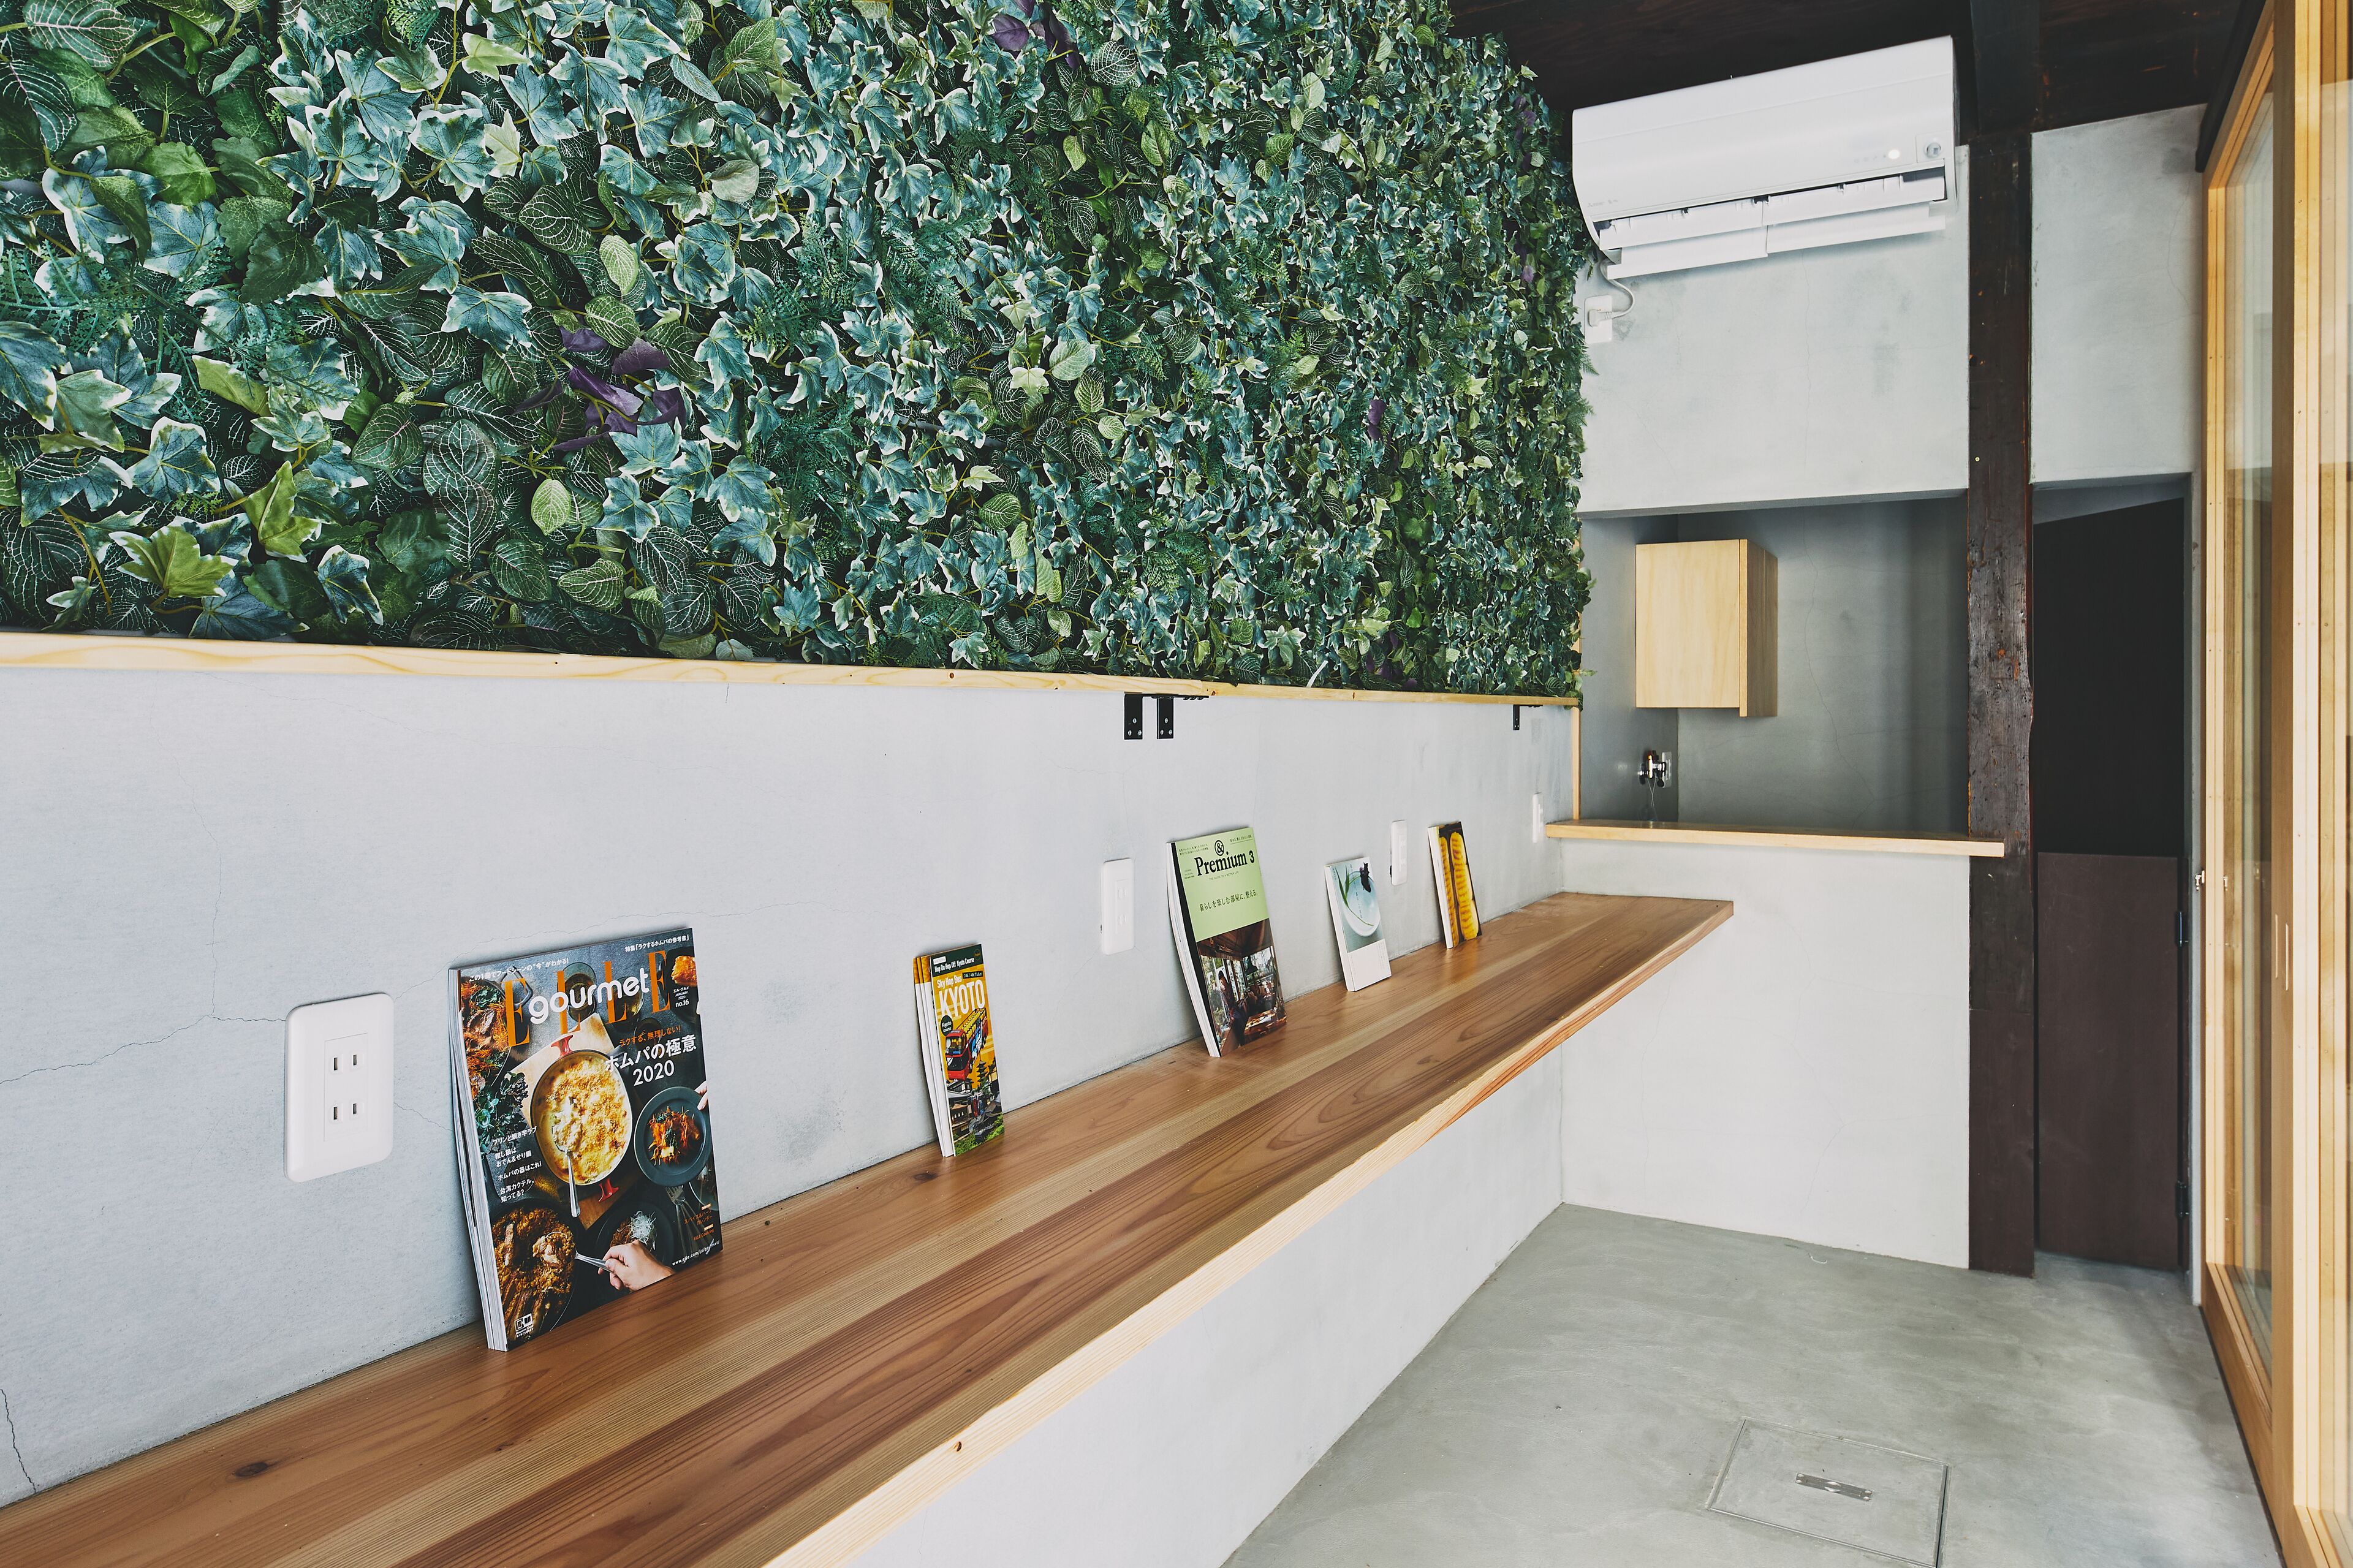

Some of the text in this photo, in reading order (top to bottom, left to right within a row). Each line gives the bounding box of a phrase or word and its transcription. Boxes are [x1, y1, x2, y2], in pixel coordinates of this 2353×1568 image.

[1194, 851, 1248, 876] Premium
[1249, 850, 1254, 863] 3
[953, 975, 962, 983] Bus
[529, 968, 650, 1025] gourmet
[675, 999, 689, 1008] no.16
[939, 979, 985, 1018] KYOTO
[605, 1034, 697, 1072] ホムパの極意
[632, 1059, 675, 1086] 2020
[494, 1147, 517, 1160] 推し鍋は
